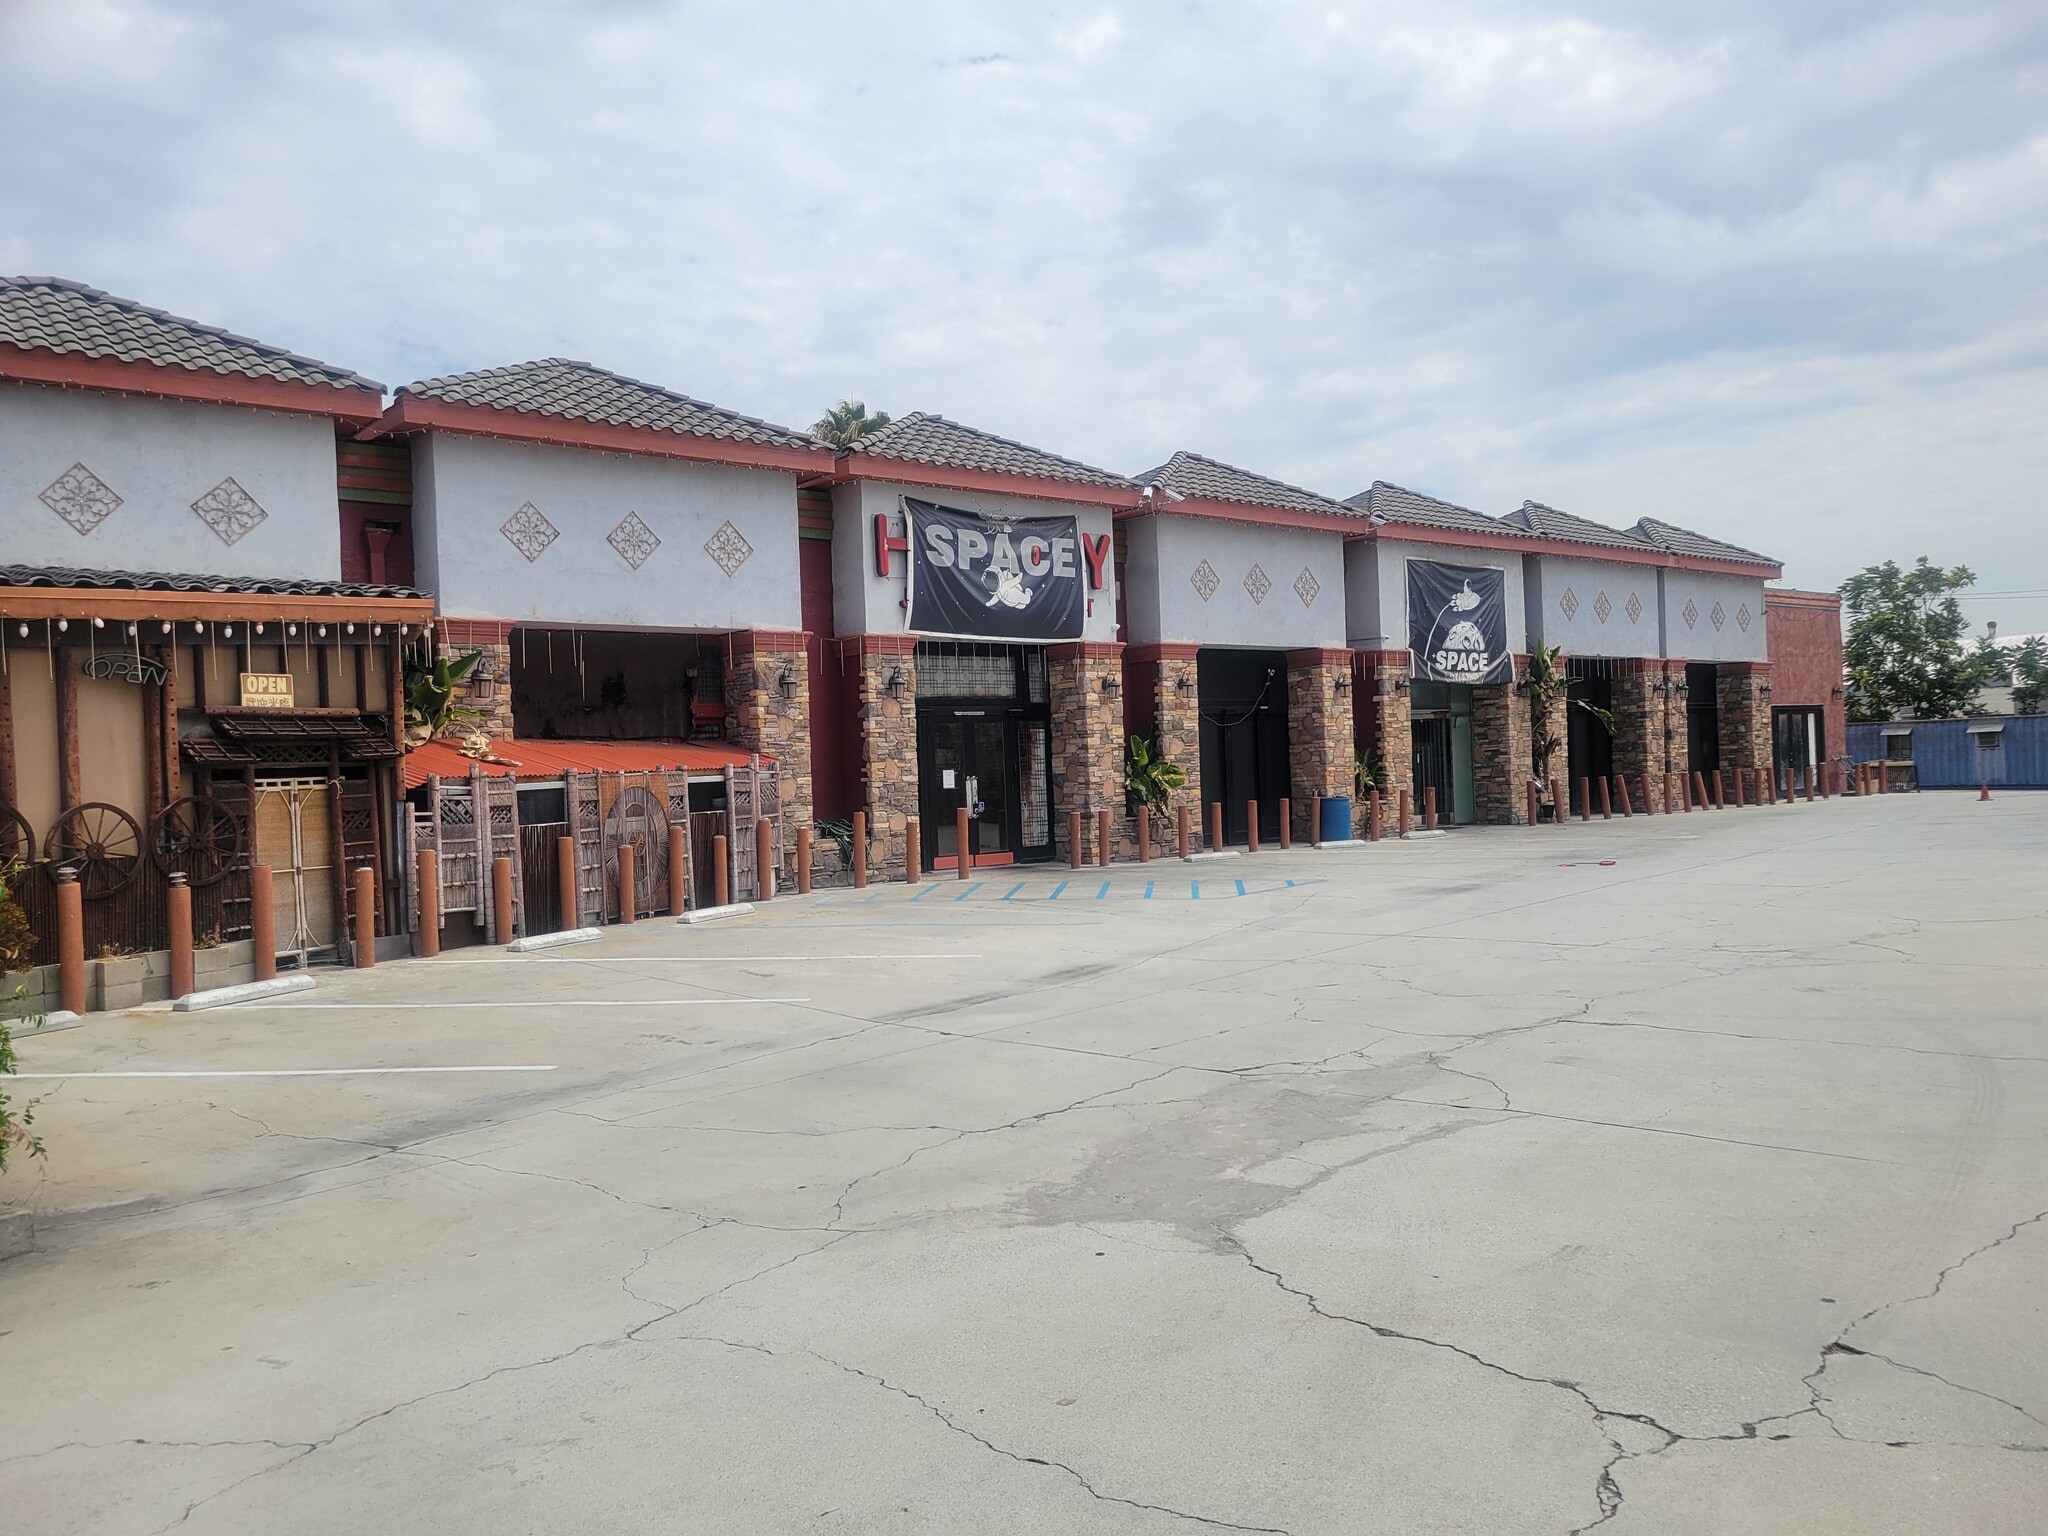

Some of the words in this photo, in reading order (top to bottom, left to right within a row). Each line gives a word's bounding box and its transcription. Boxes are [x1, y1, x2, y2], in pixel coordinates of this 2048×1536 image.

[925, 524, 1076, 578] SPACE
[89, 659, 168, 686] OPEN
[1435, 650, 1489, 671] SPACE
[247, 676, 287, 693] OPEN
